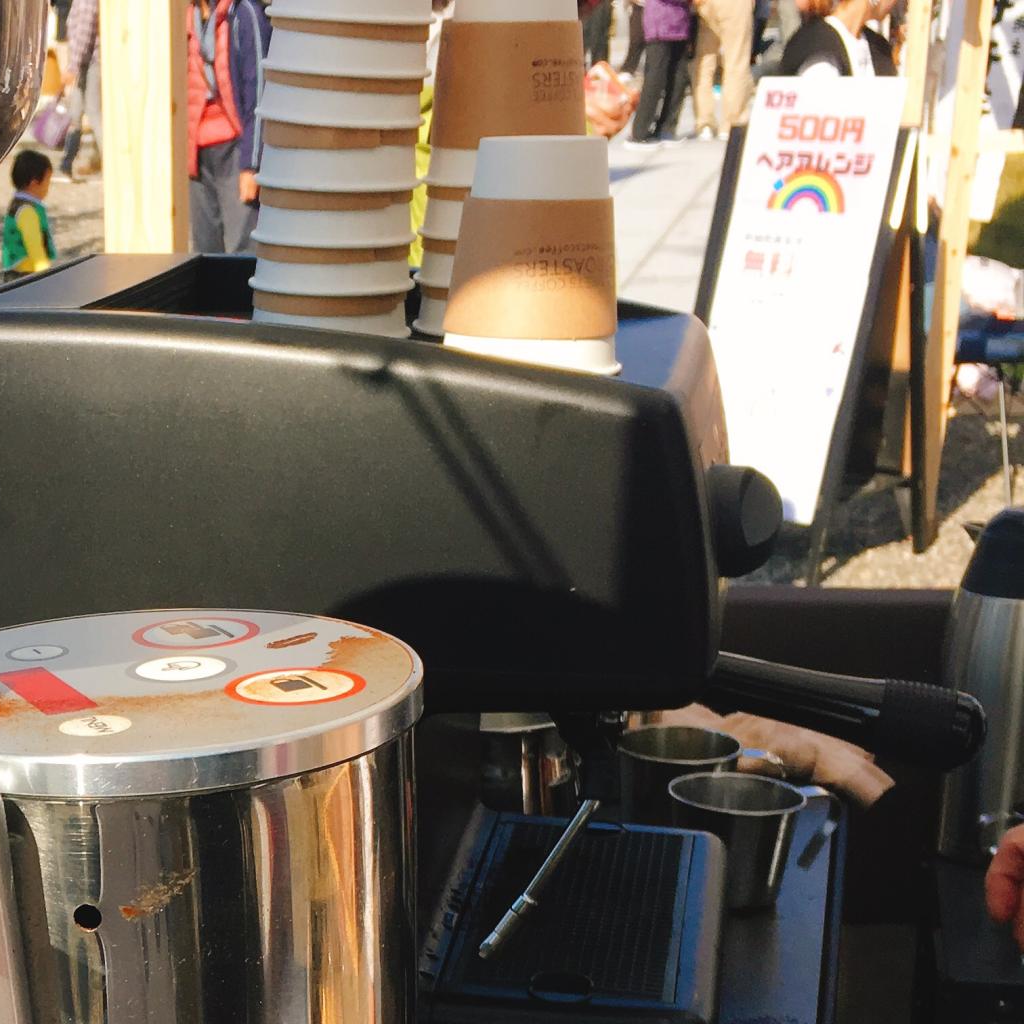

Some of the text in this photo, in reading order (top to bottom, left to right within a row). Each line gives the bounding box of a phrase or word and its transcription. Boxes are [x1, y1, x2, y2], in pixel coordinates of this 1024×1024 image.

[777, 114, 865, 143] 500円
[756, 151, 875, 175] ヘアアレンジ
